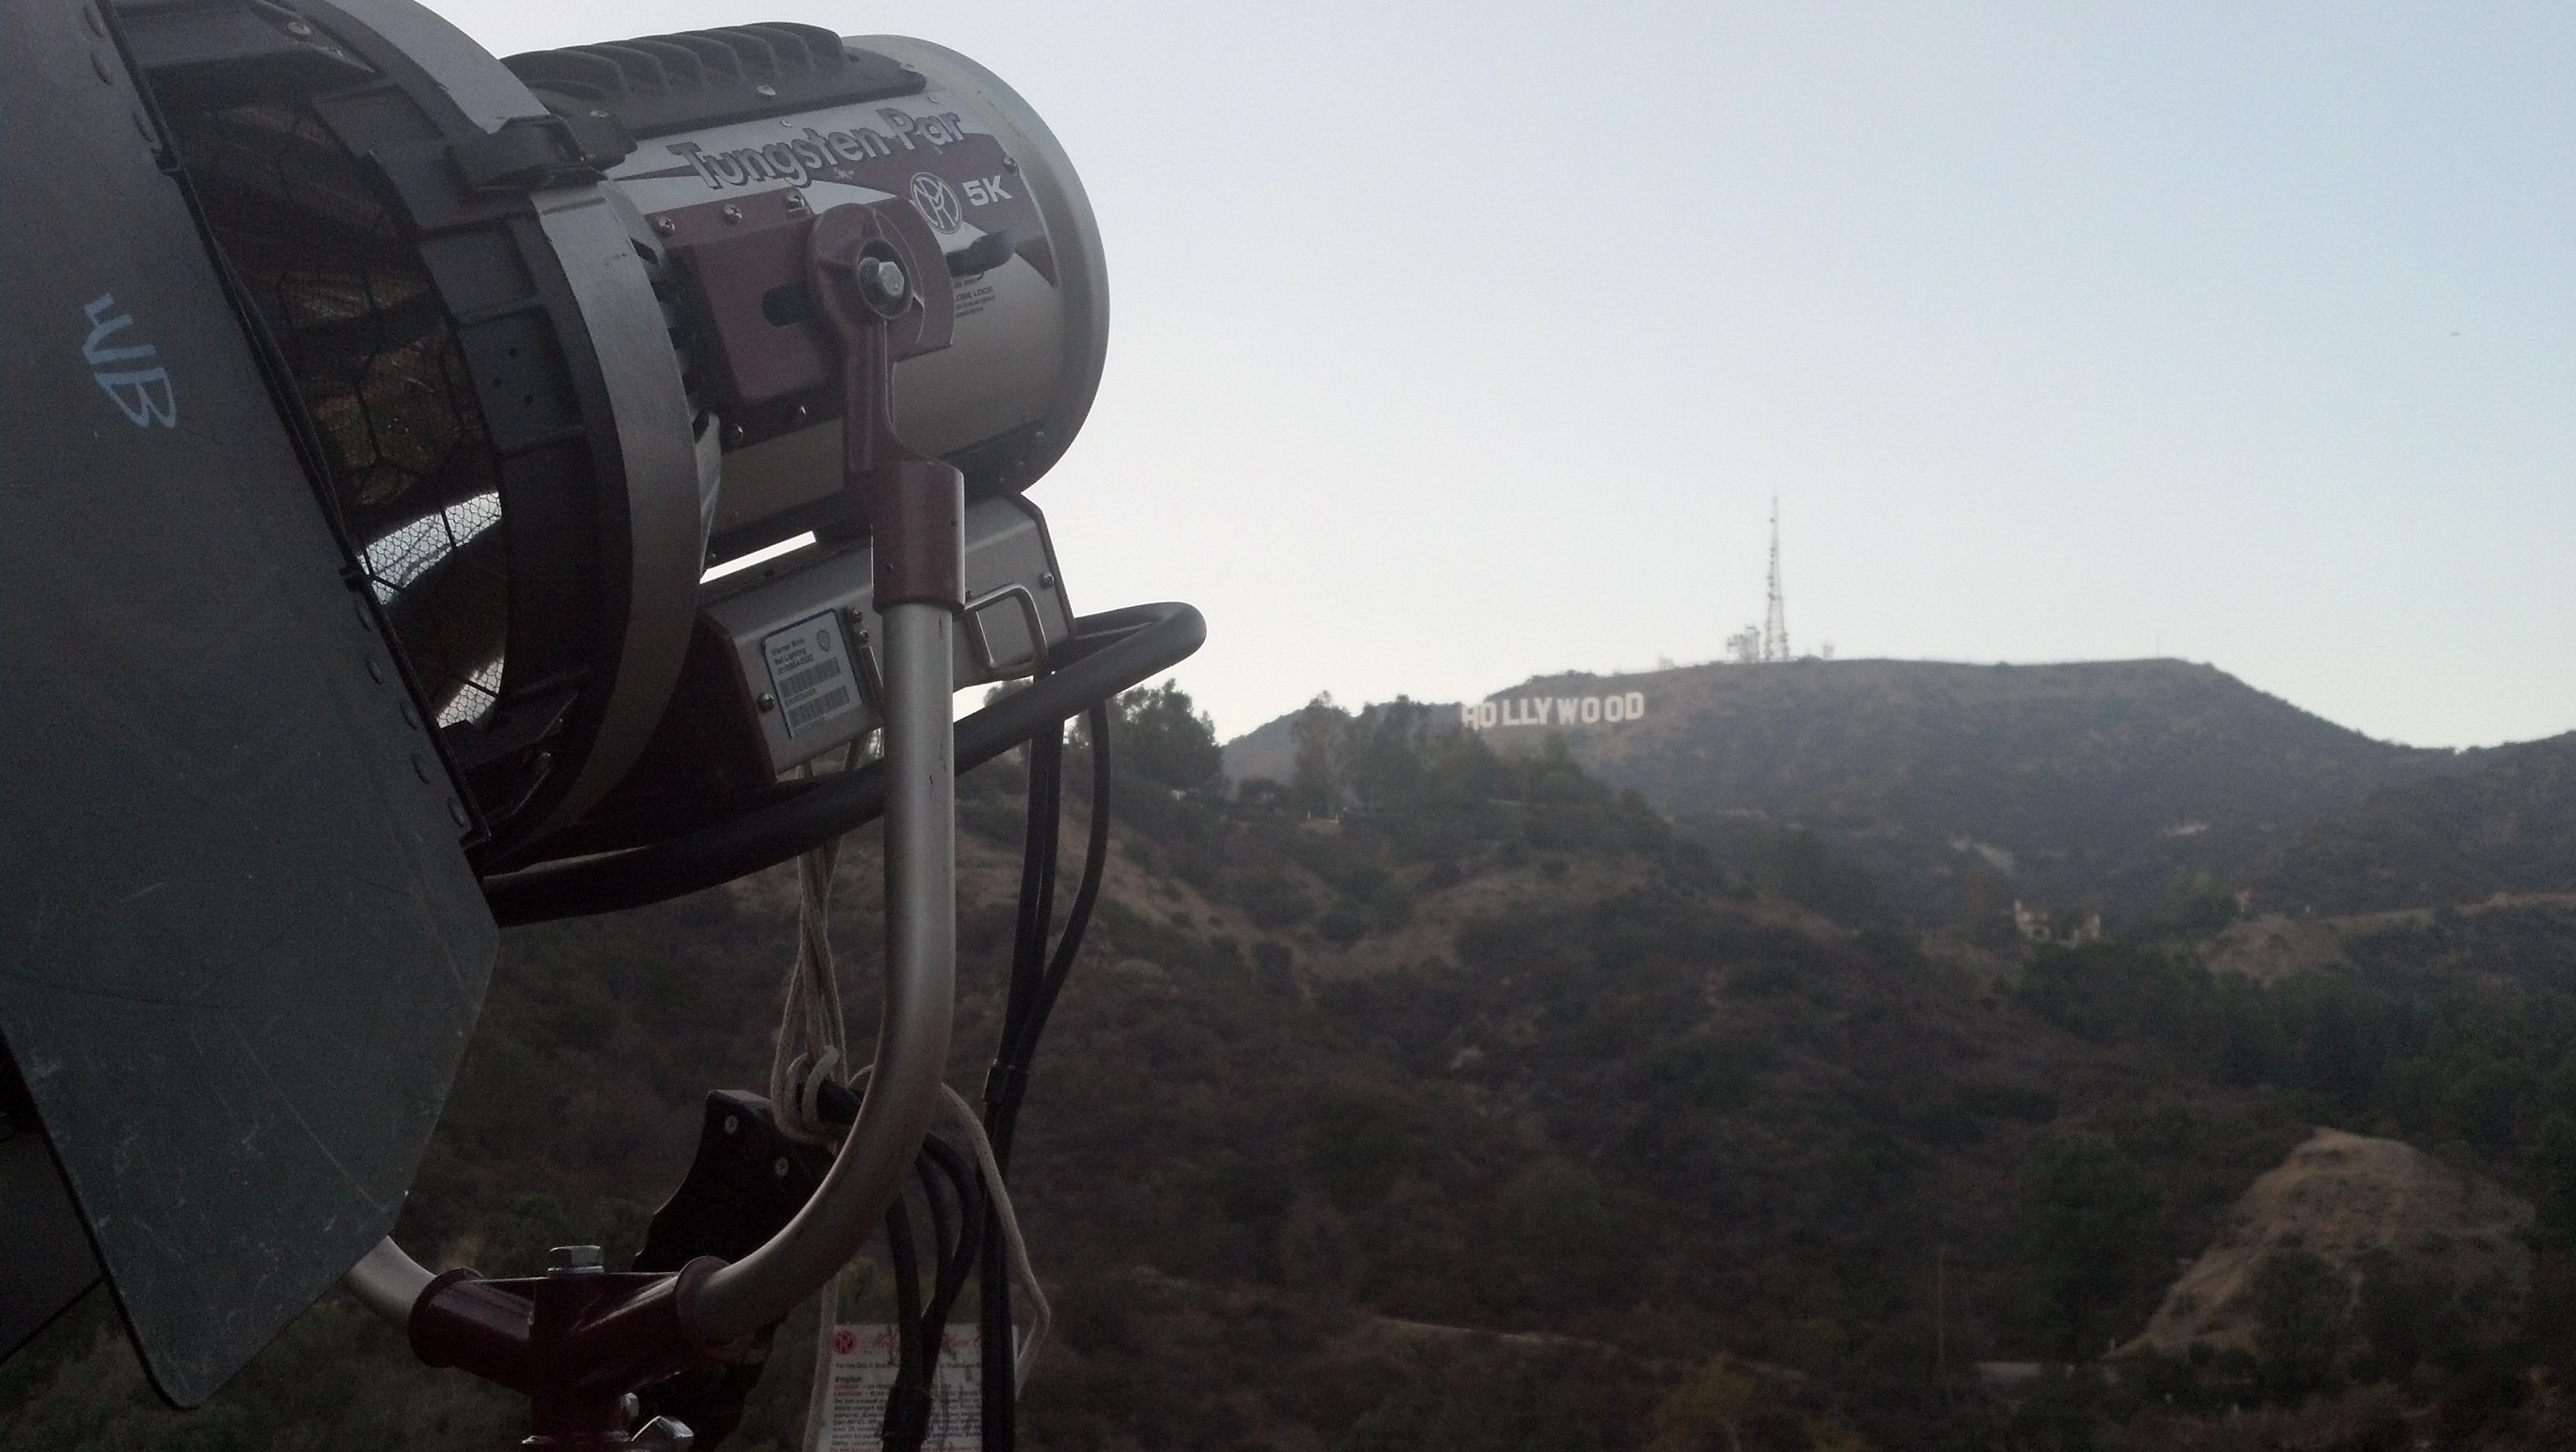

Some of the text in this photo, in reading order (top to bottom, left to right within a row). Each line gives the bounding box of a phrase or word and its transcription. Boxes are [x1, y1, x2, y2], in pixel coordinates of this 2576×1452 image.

[666, 107, 965, 189] Tungsten Par
[962, 174, 1013, 206] 5K
[81, 293, 177, 429] WB
[1460, 690, 1645, 731] HOLLYWOOD
